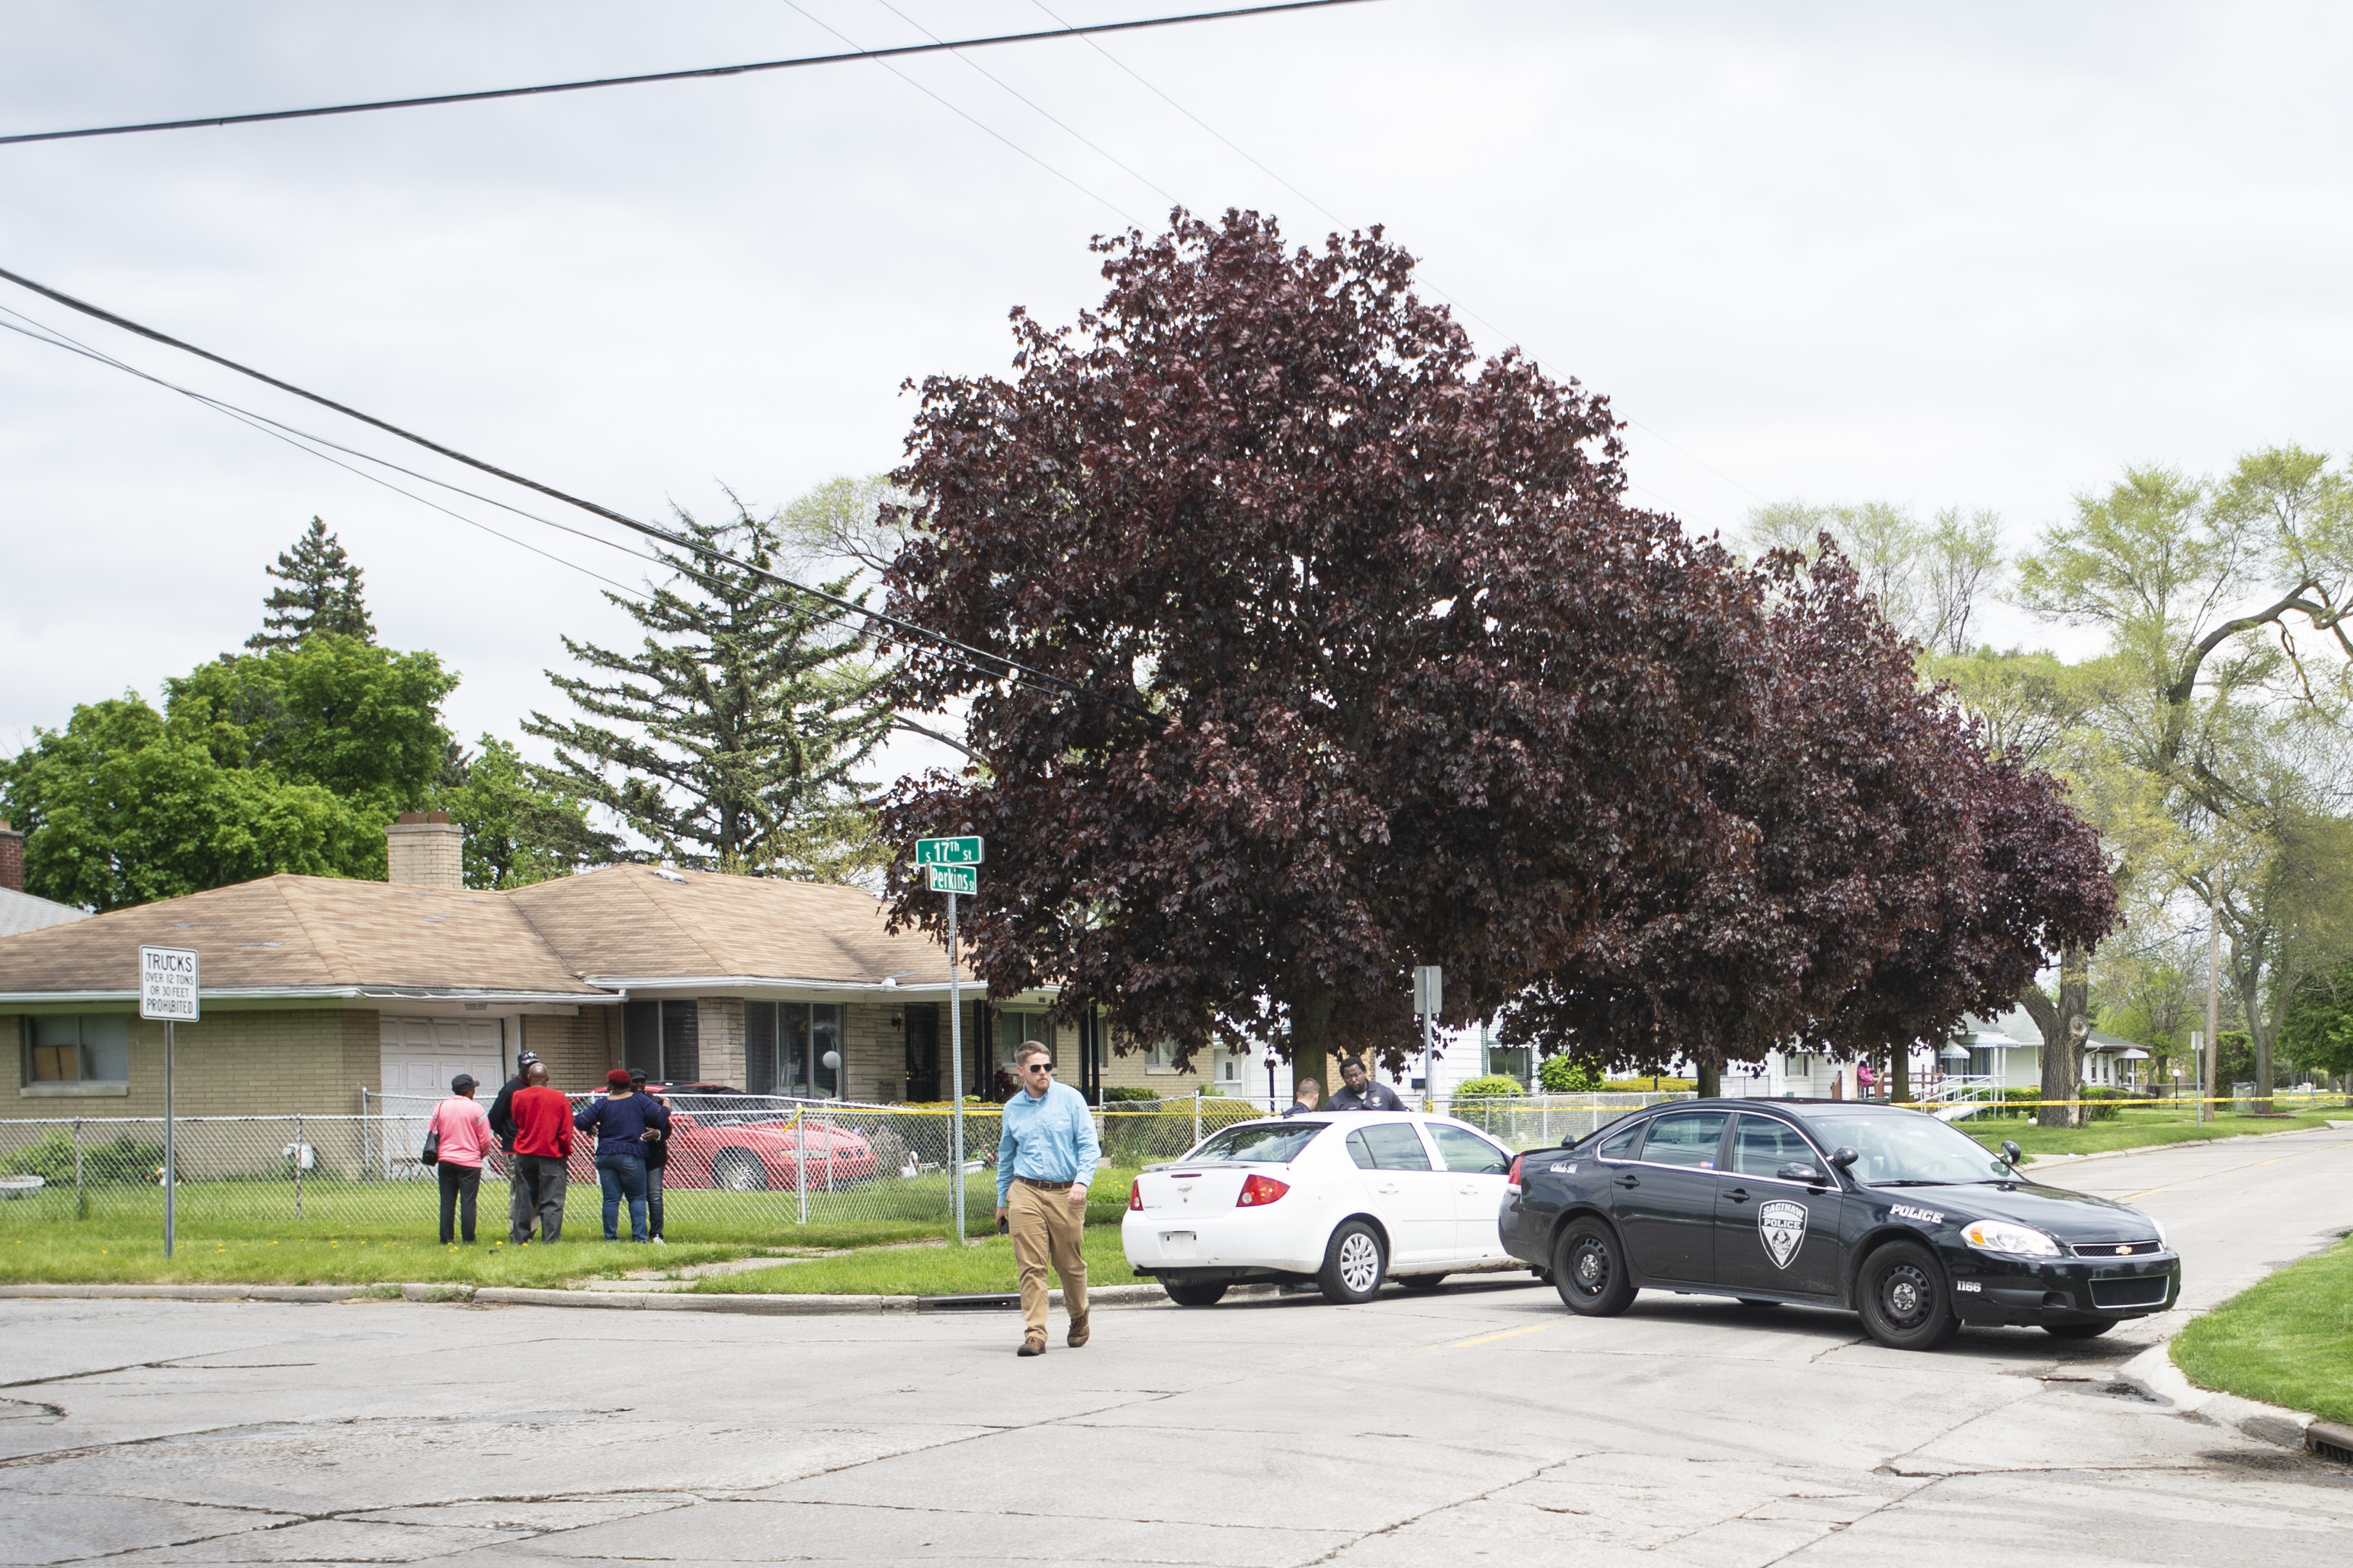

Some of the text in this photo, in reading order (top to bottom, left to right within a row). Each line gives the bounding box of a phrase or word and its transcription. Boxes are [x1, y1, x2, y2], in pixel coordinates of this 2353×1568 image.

[932, 867, 968, 890] Perkins
[146, 953, 193, 972] TRUCKS
[145, 972, 194, 986] OVER 12 TONS
[150, 986, 189, 998] OR 30 FEET
[147, 998, 193, 1014] PROHIBITED
[1763, 1203, 1805, 1219] SAGINAW
[1890, 1203, 1945, 1224] POLICE
[1764, 1219, 1801, 1230] POLICE
[1956, 1280, 1981, 1293] 1166
